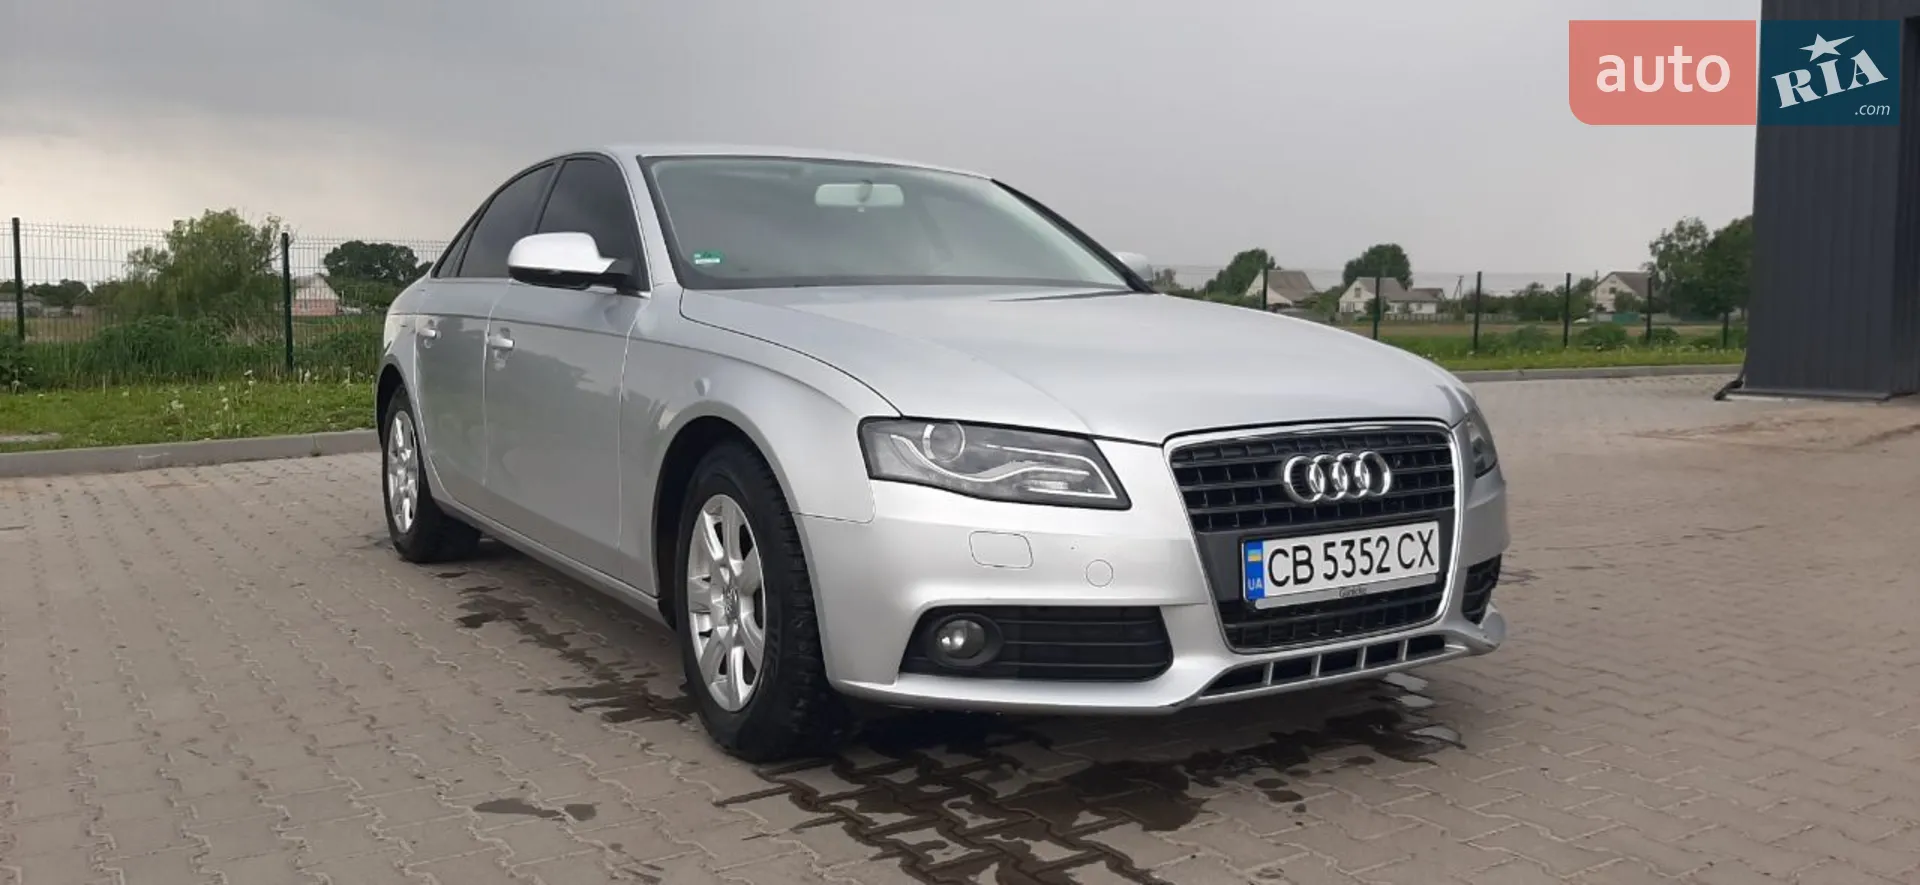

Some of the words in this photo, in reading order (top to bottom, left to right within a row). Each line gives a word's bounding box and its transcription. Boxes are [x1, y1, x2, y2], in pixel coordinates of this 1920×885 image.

[1268, 546, 1314, 587] CB
[1323, 536, 1391, 580] 5352
[1397, 529, 1435, 569] CX
[1247, 577, 1263, 591] UA
